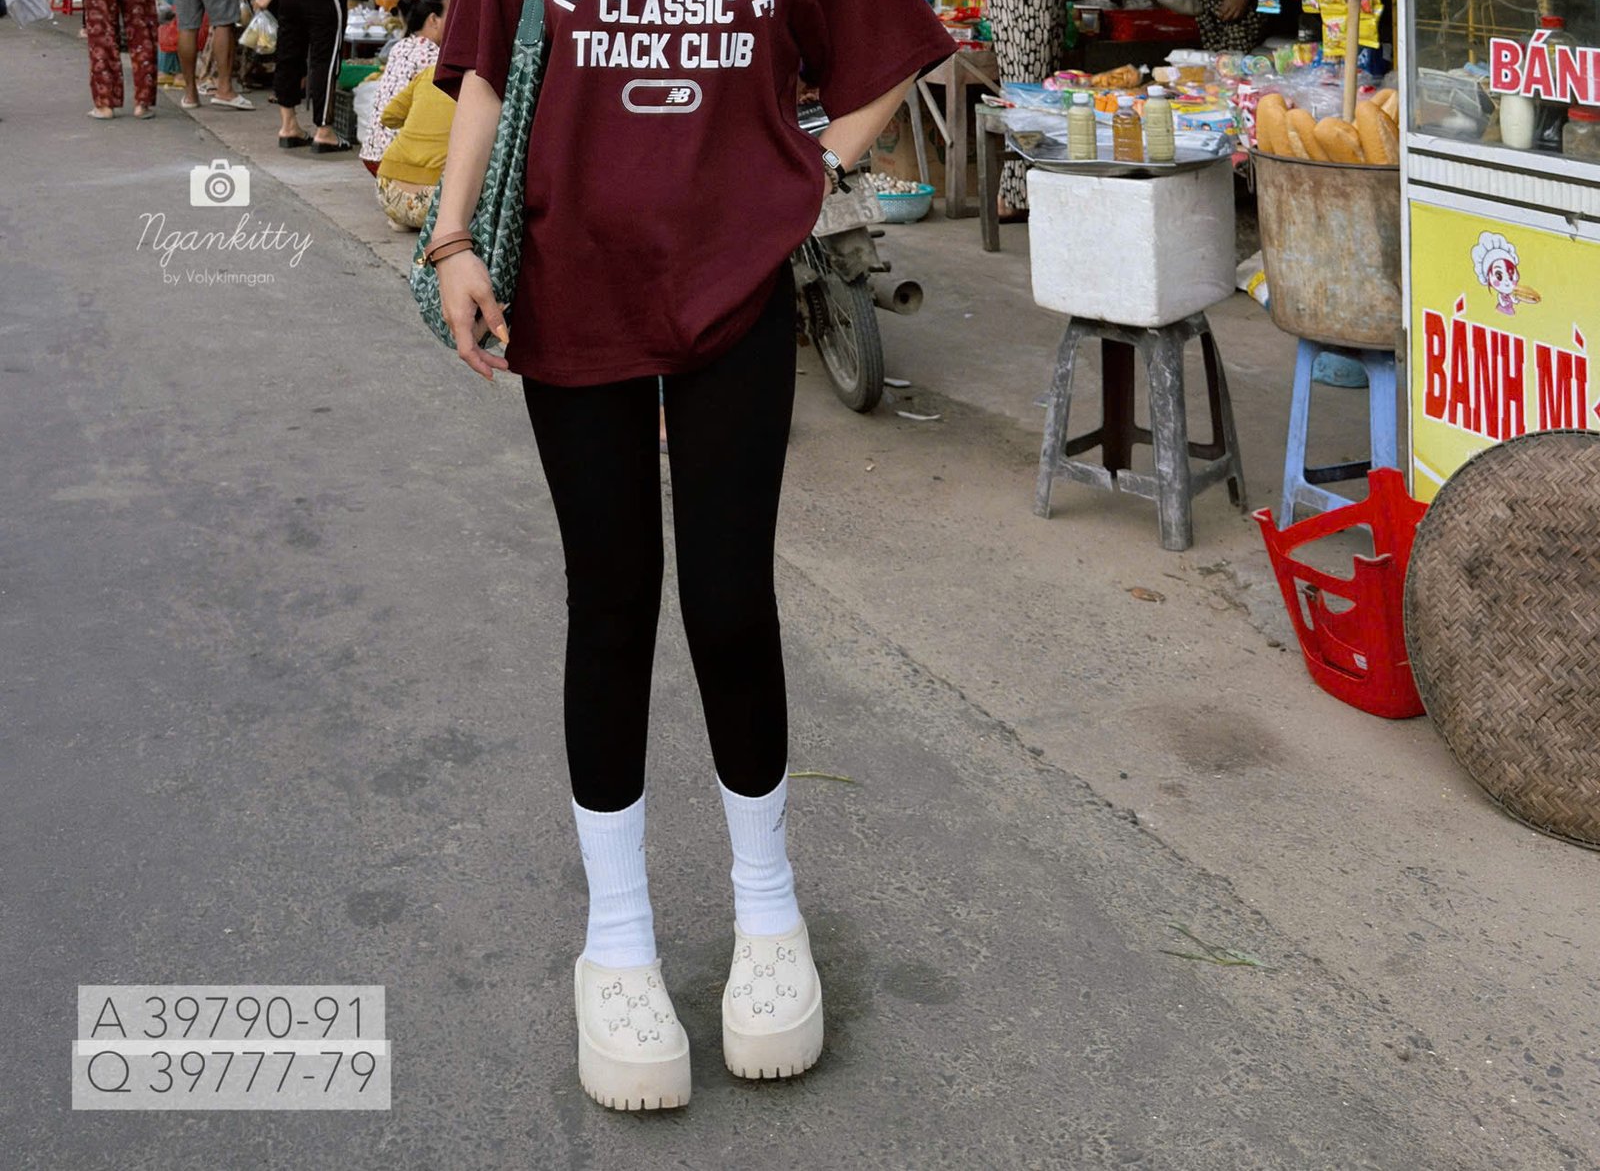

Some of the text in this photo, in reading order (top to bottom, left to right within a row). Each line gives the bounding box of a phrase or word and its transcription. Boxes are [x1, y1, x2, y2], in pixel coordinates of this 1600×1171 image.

[572, 31, 755, 69] TRACK CLUB
[1490, 29, 1600, 106] BÁN
[1424, 293, 1590, 444] BÁNH MÌ
